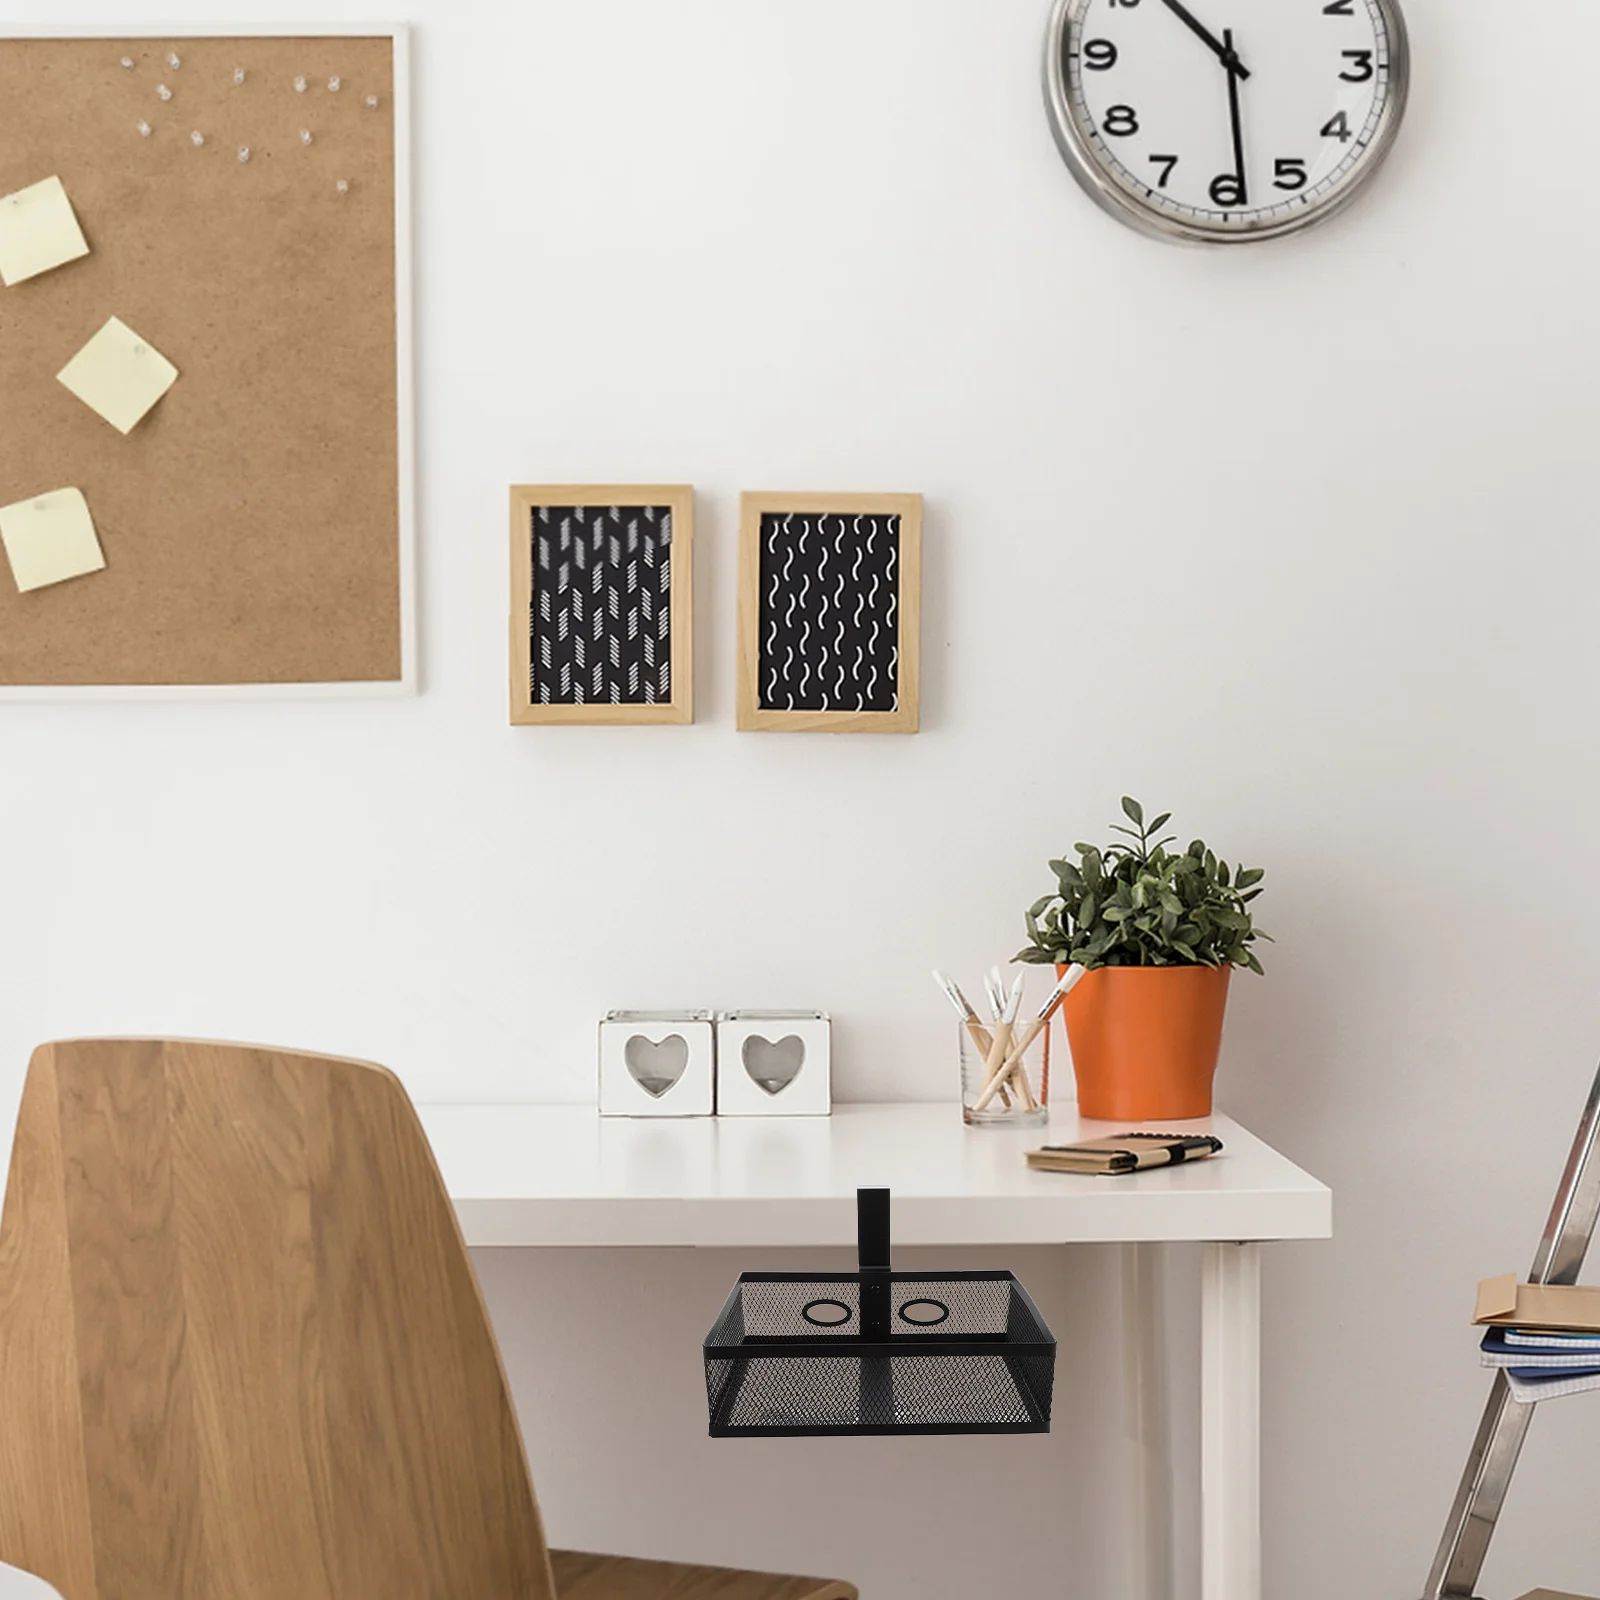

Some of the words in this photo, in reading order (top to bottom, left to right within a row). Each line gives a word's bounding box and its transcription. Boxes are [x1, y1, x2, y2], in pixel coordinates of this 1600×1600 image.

[1083, 38, 1118, 71] 9
[1338, 49, 1374, 83] 3
[1102, 105, 1140, 137] 8
[1319, 111, 1352, 143] 4
[1148, 154, 1179, 188] 7
[1272, 158, 1308, 190] 5
[1208, 173, 1242, 208] 6
